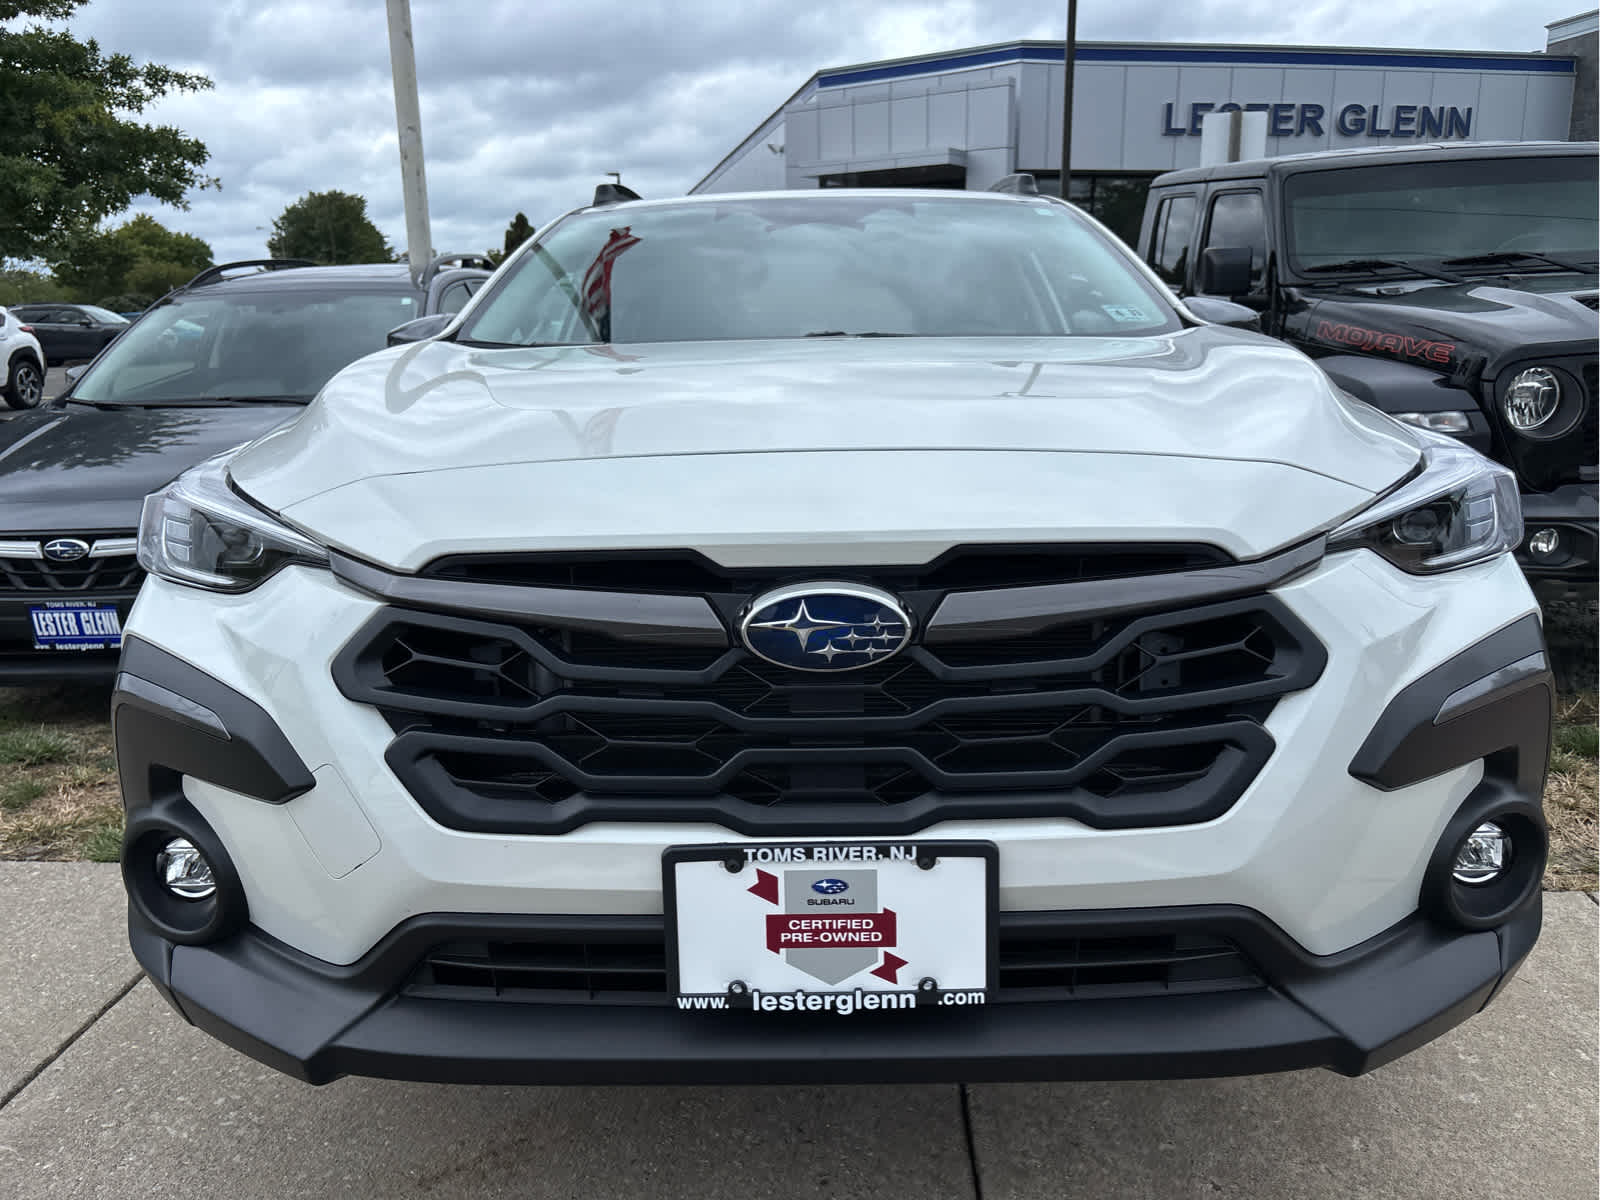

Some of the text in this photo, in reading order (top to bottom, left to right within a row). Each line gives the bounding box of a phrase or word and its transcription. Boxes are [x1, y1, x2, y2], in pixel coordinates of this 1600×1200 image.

[1163, 102, 1472, 139] LEER GLENN
[1317, 320, 1455, 363] MOJAVE
[32, 611, 121, 636] LESTER GLENN
[744, 846, 918, 863] TOMS RIVER, NJ
[807, 898, 855, 906] SUBARU
[788, 919, 874, 931] CERTIFIED
[780, 931, 883, 943] PRE-OWNED
[677, 990, 985, 1015] www. lesterglenn .com
